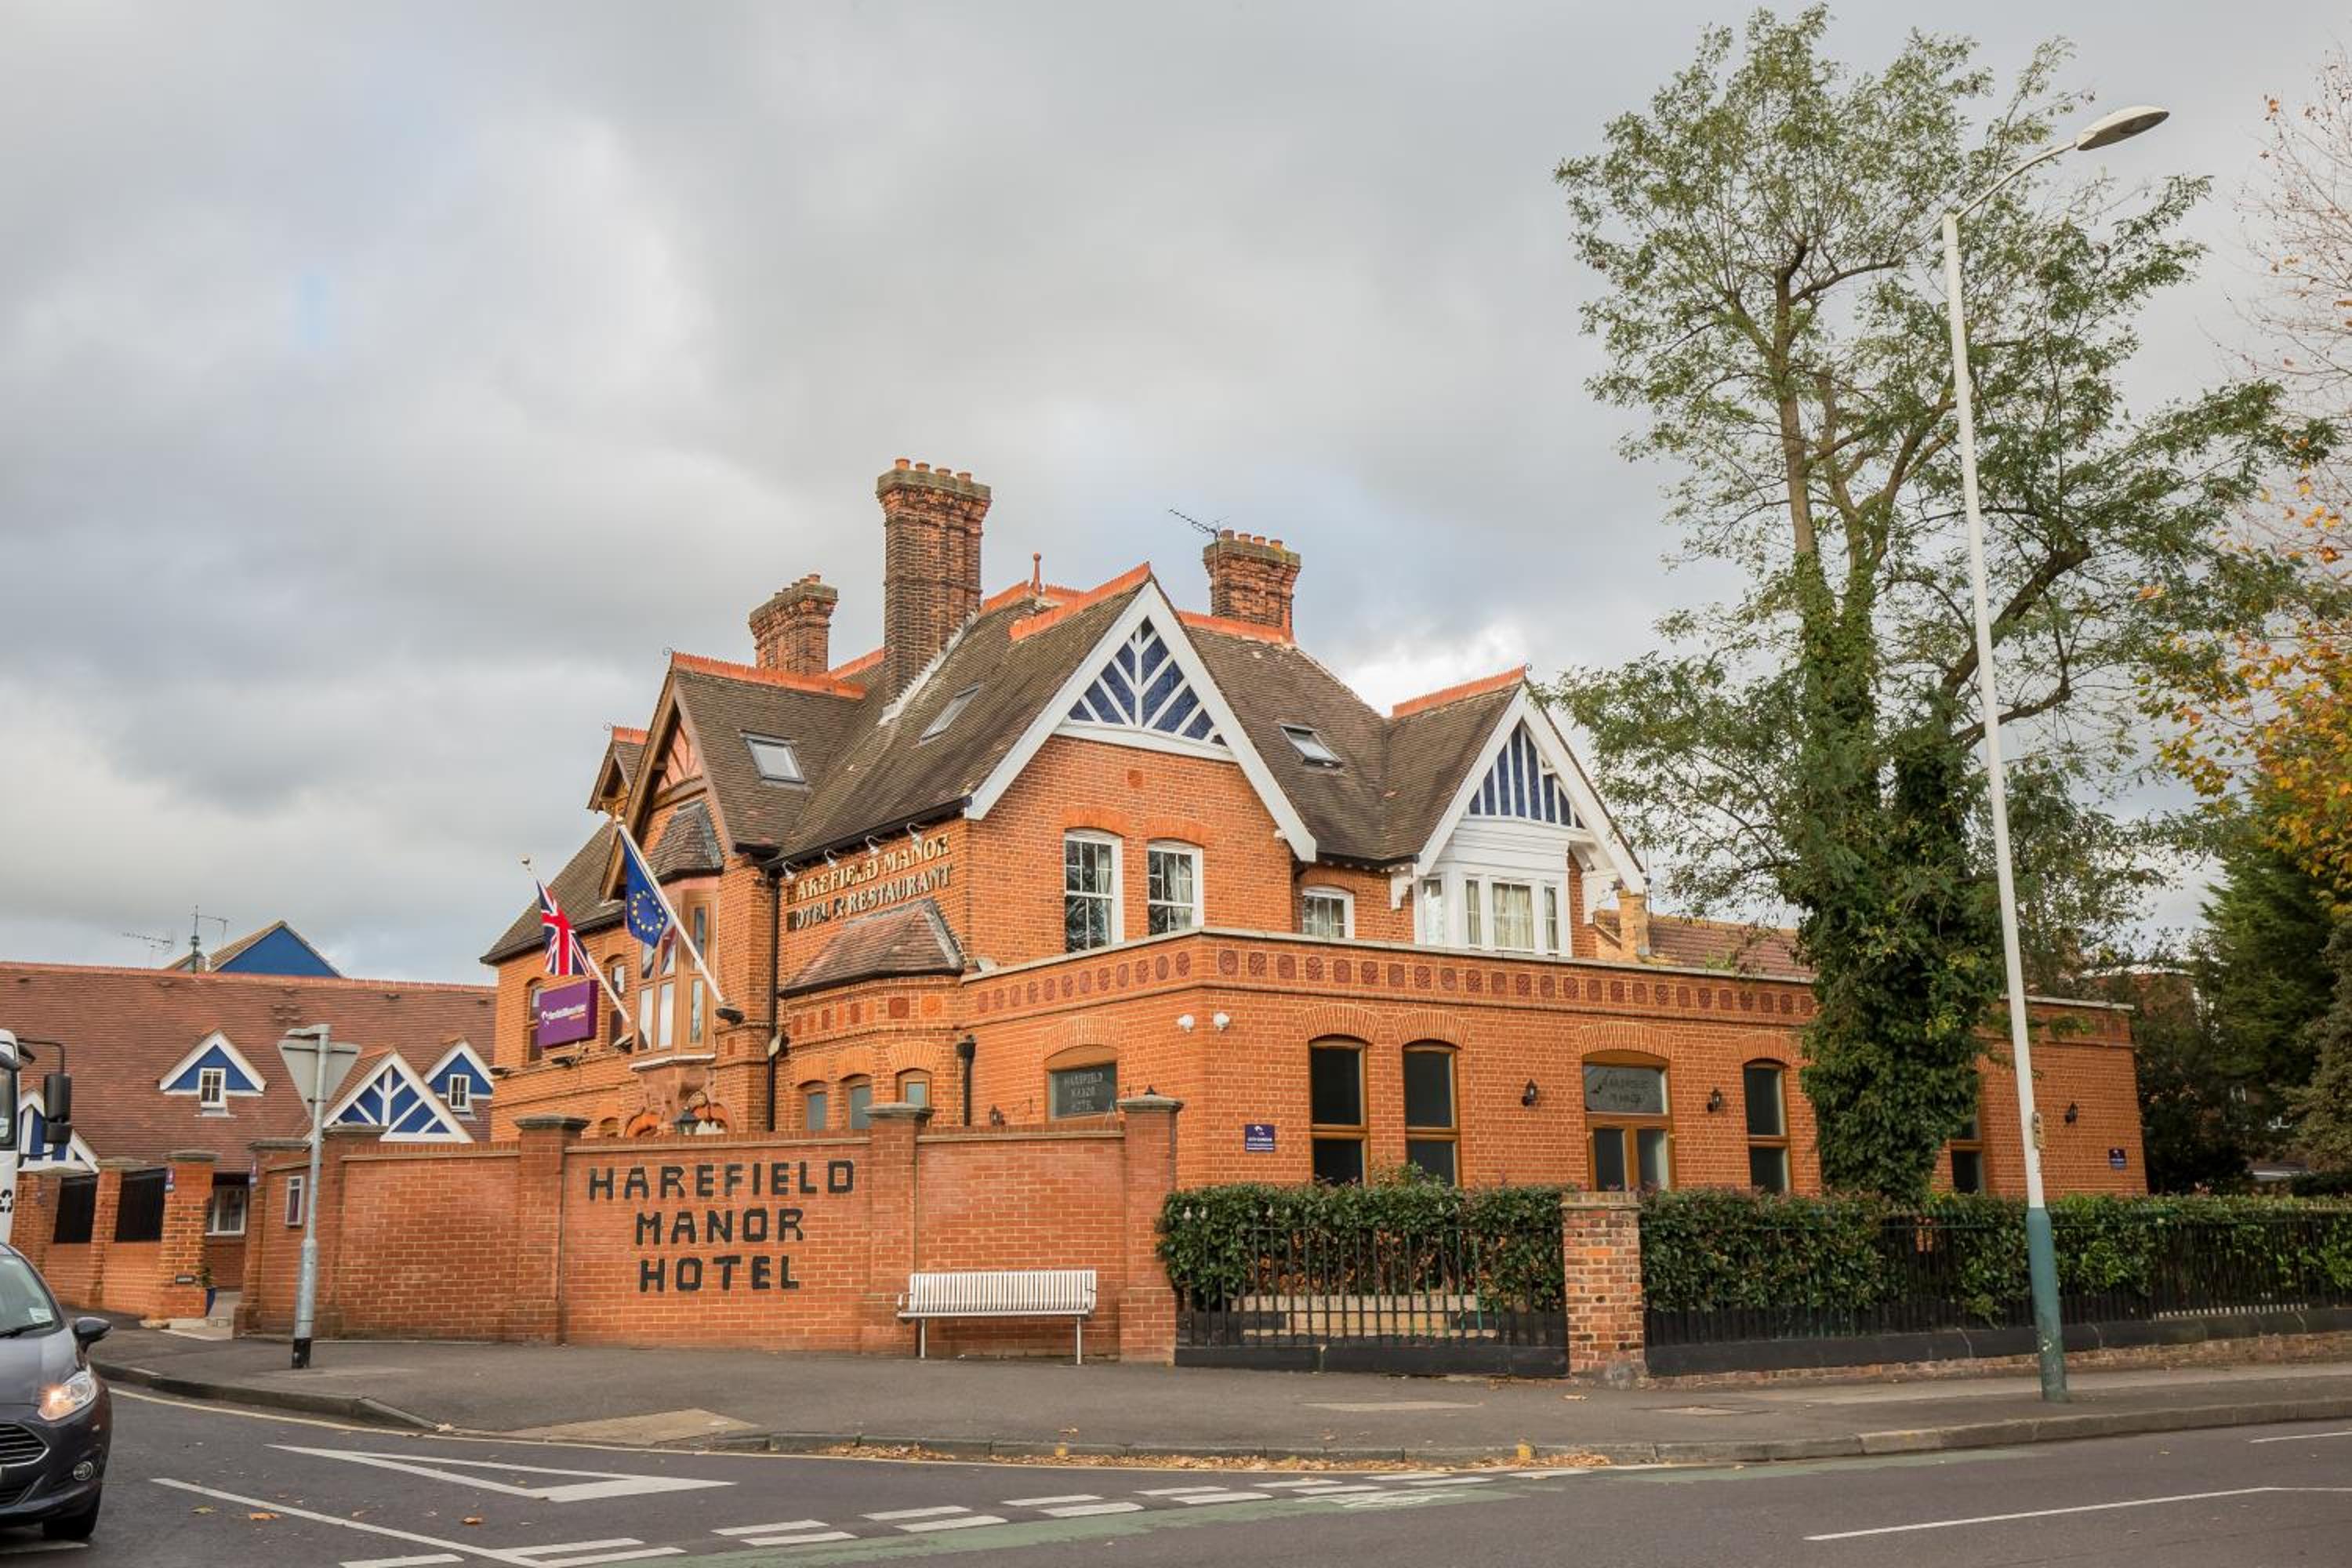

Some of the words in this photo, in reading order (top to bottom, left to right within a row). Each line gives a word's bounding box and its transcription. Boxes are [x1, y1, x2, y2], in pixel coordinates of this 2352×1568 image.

[787, 859, 879, 904] AREFIELD
[884, 834, 950, 874] MANOR
[787, 902, 830, 931] OTEL
[848, 862, 953, 914] RESTAURANT
[590, 1160, 853, 1200] HAREFIELD
[636, 1208, 804, 1245] MANOR
[639, 1255, 800, 1292] HOTEL
